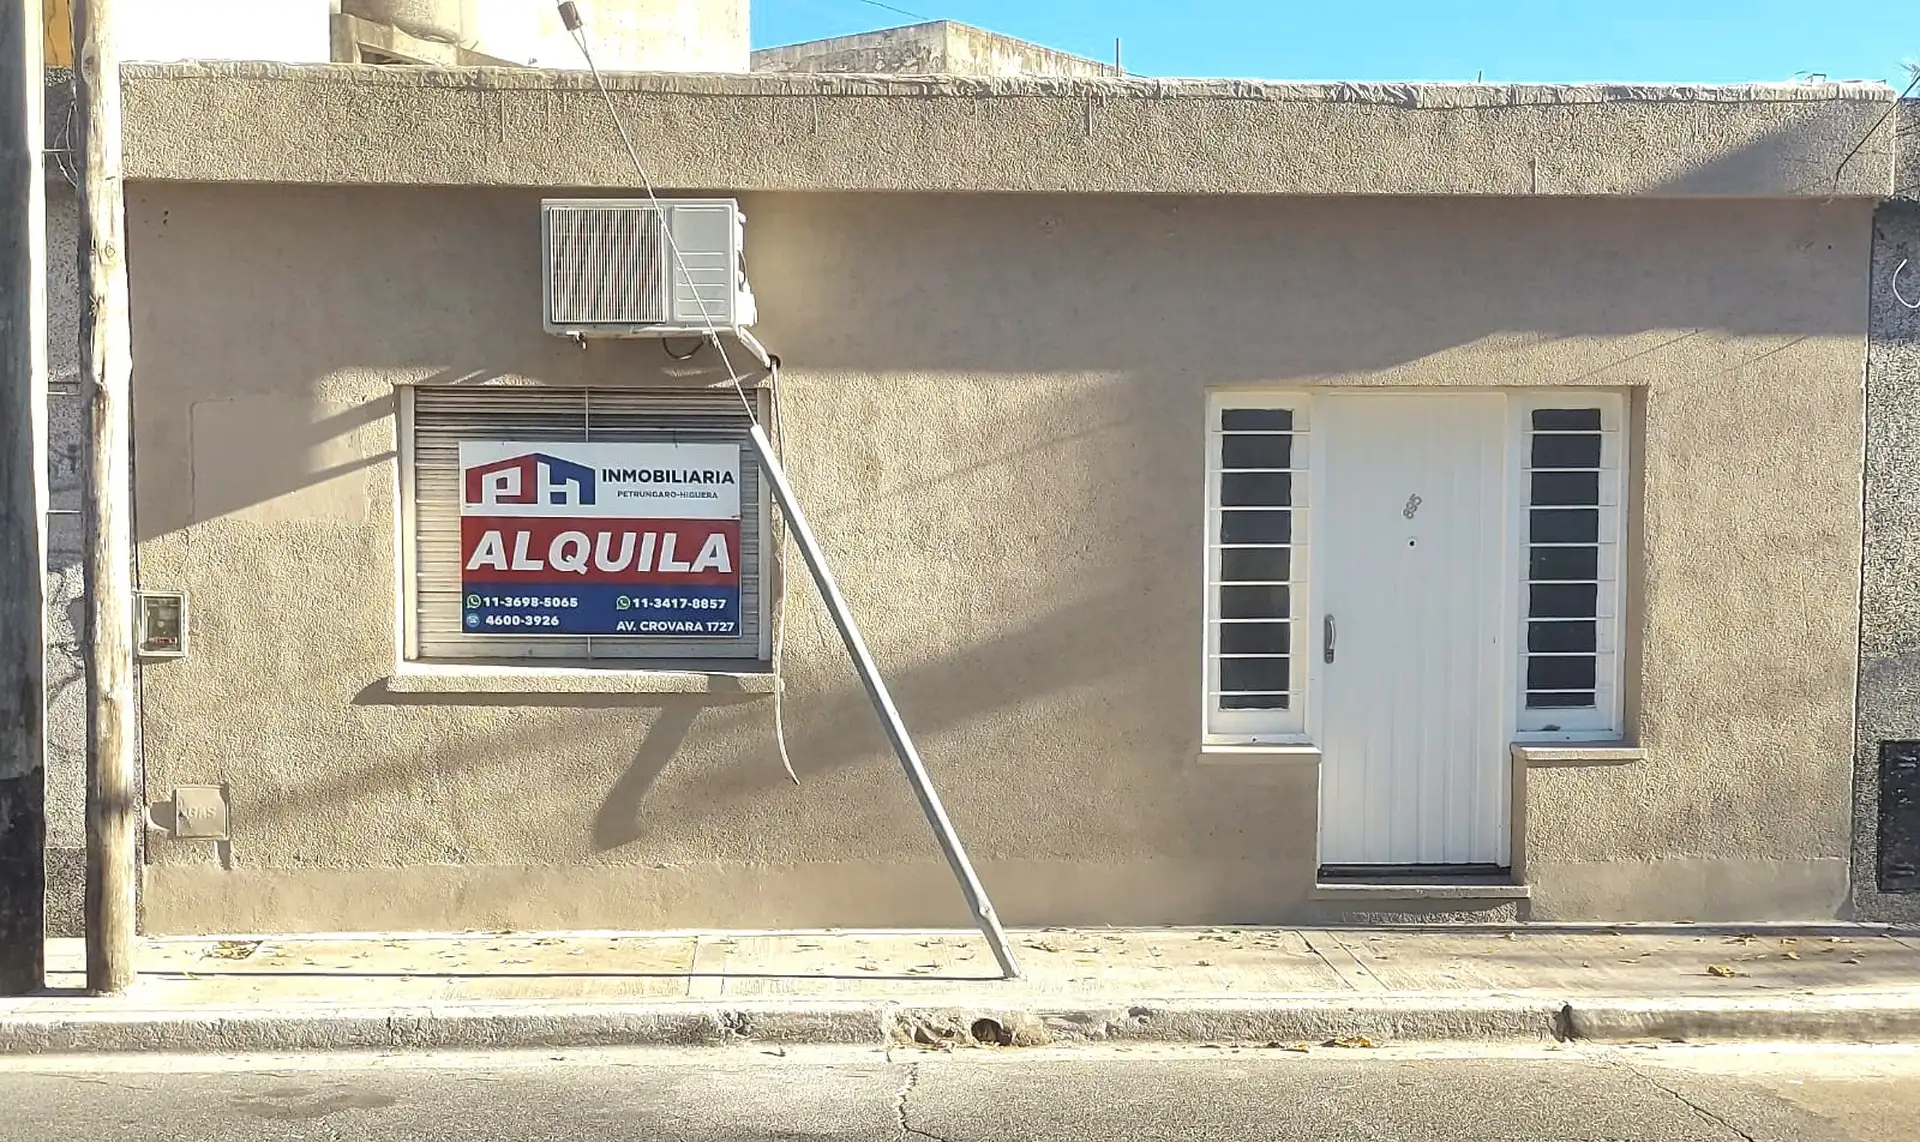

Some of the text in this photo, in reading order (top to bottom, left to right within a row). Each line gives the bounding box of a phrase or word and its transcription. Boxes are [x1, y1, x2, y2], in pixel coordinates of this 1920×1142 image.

[602, 468, 734, 484] INMOBILIARIA
[617, 490, 718, 499] PETRUNGARO-HIGUERA
[466, 530, 732, 575] ALQUILA
[483, 596, 578, 608] 11-3698-5065
[632, 598, 726, 608] 11-3417-8857
[486, 616, 559, 626] 4600-3926
[616, 622, 734, 632] AV. CROVARA 1727
